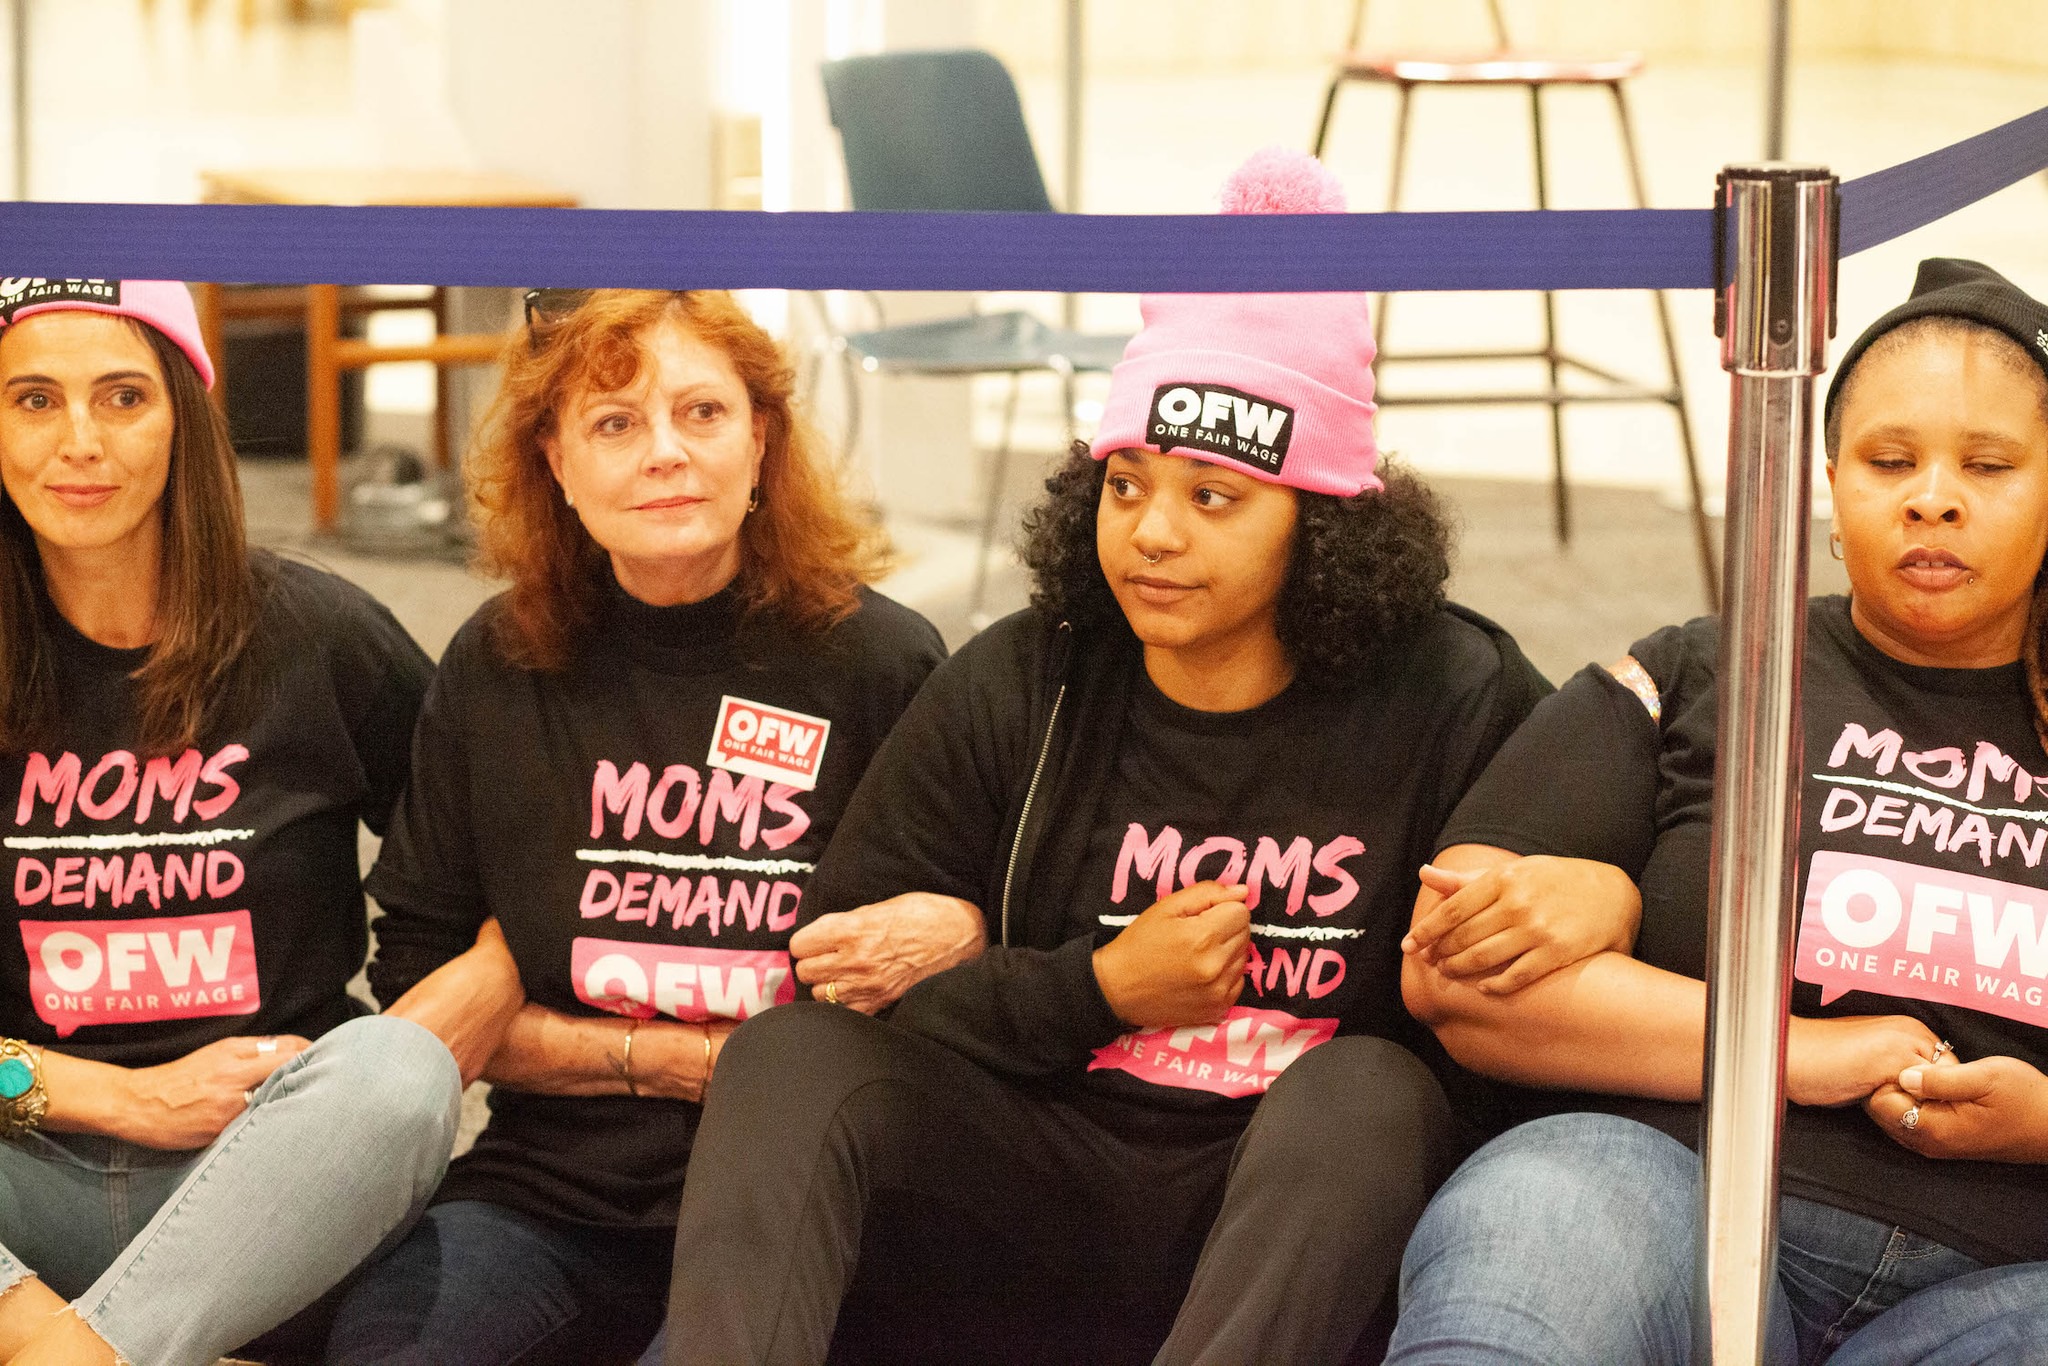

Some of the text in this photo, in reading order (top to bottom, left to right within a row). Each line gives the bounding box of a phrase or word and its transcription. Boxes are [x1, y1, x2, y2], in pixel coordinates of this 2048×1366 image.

[29, 284, 61, 298] FAIR
[67, 284, 113, 297] WAGE
[1155, 424, 1279, 465] ONE FAIR WAGE
[1157, 387, 1288, 447] OFW
[723, 738, 811, 769] ONE FAIR WAGE
[728, 709, 818, 757] OFW
[1827, 722, 2048, 804] MOM
[15, 744, 250, 828] MOMS
[590, 759, 816, 851] MOMS
[1819, 787, 2048, 868] DEMAN
[14, 850, 245, 910] DEMAND
[1110, 822, 1367, 917] MOMS
[579, 868, 803, 937] DEMAND
[1820, 868, 2048, 979] OFW
[40, 924, 237, 993] OFW
[584, 953, 789, 1020] OFW
[1243, 941, 1347, 999] AND
[1815, 947, 2048, 1008] ONE FAIR WAG
[44, 984, 245, 1012] ONE FAIR WAGE
[1116, 1034, 1277, 1091] NE FAIR WA
